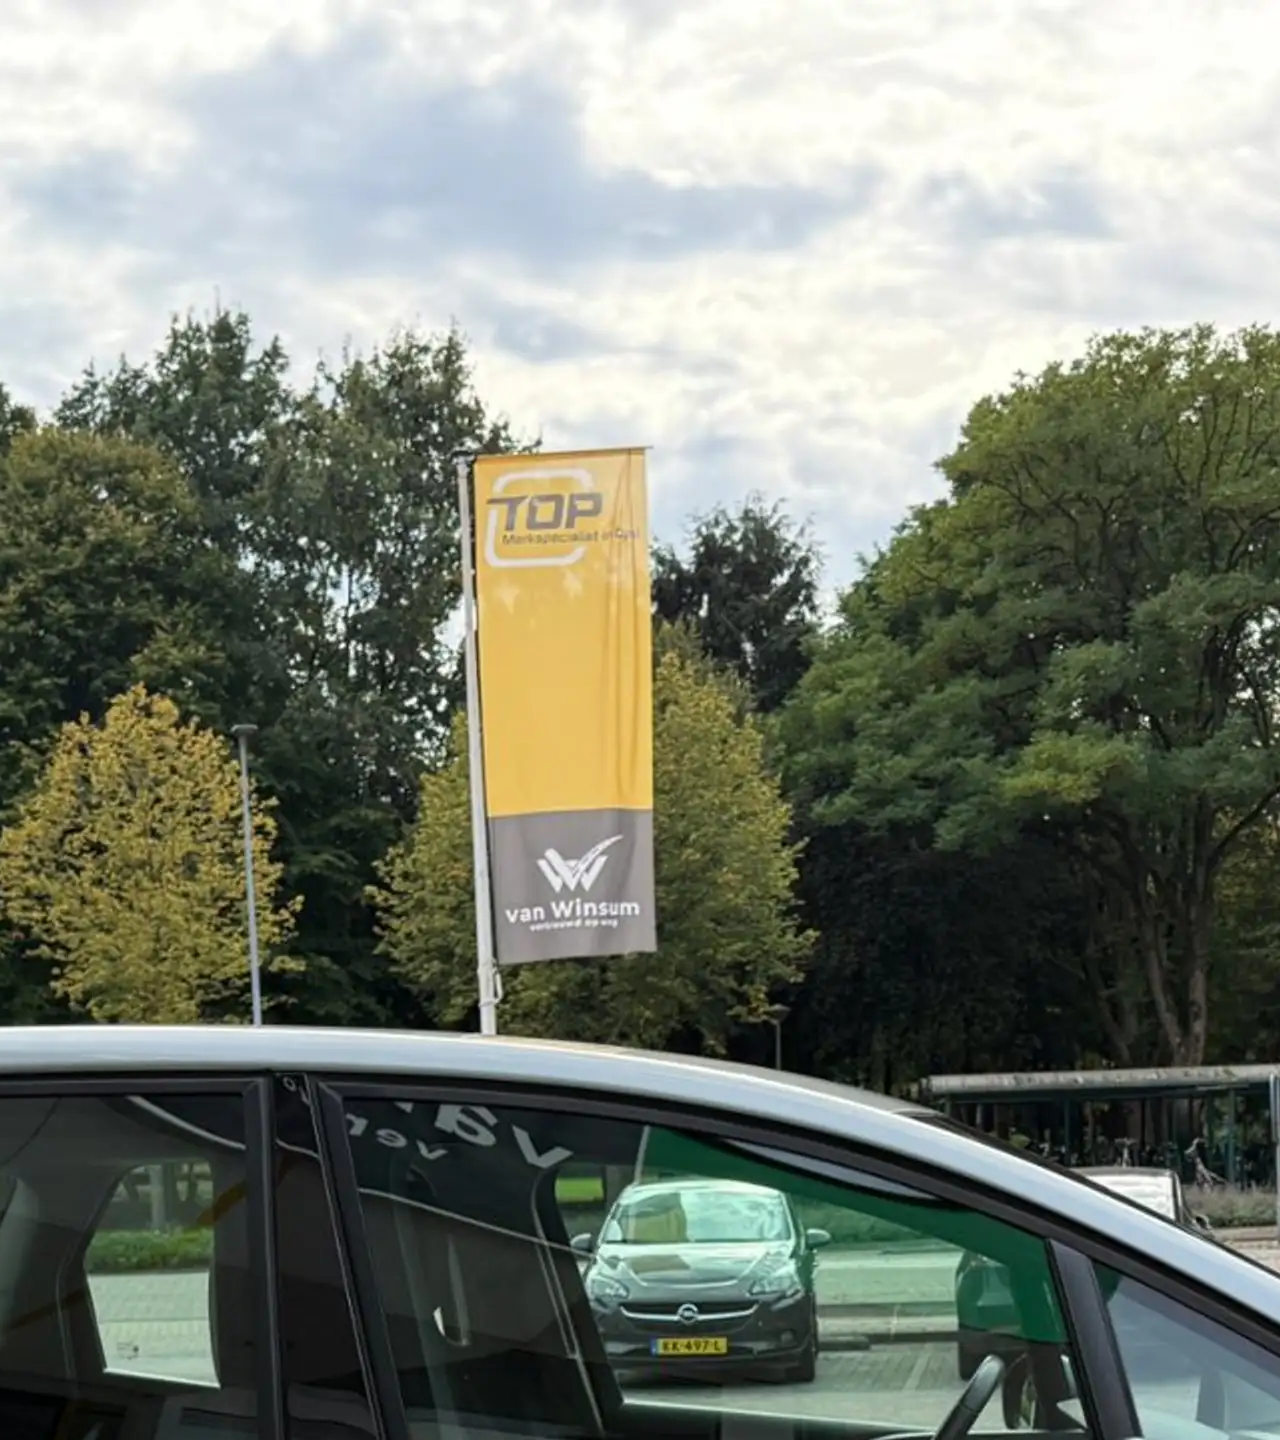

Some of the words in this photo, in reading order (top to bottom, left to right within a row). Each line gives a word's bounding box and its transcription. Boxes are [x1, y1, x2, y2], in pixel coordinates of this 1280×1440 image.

[486, 492, 603, 531] TOP
[505, 905, 546, 924] van
[550, 898, 641, 919] Winsum
